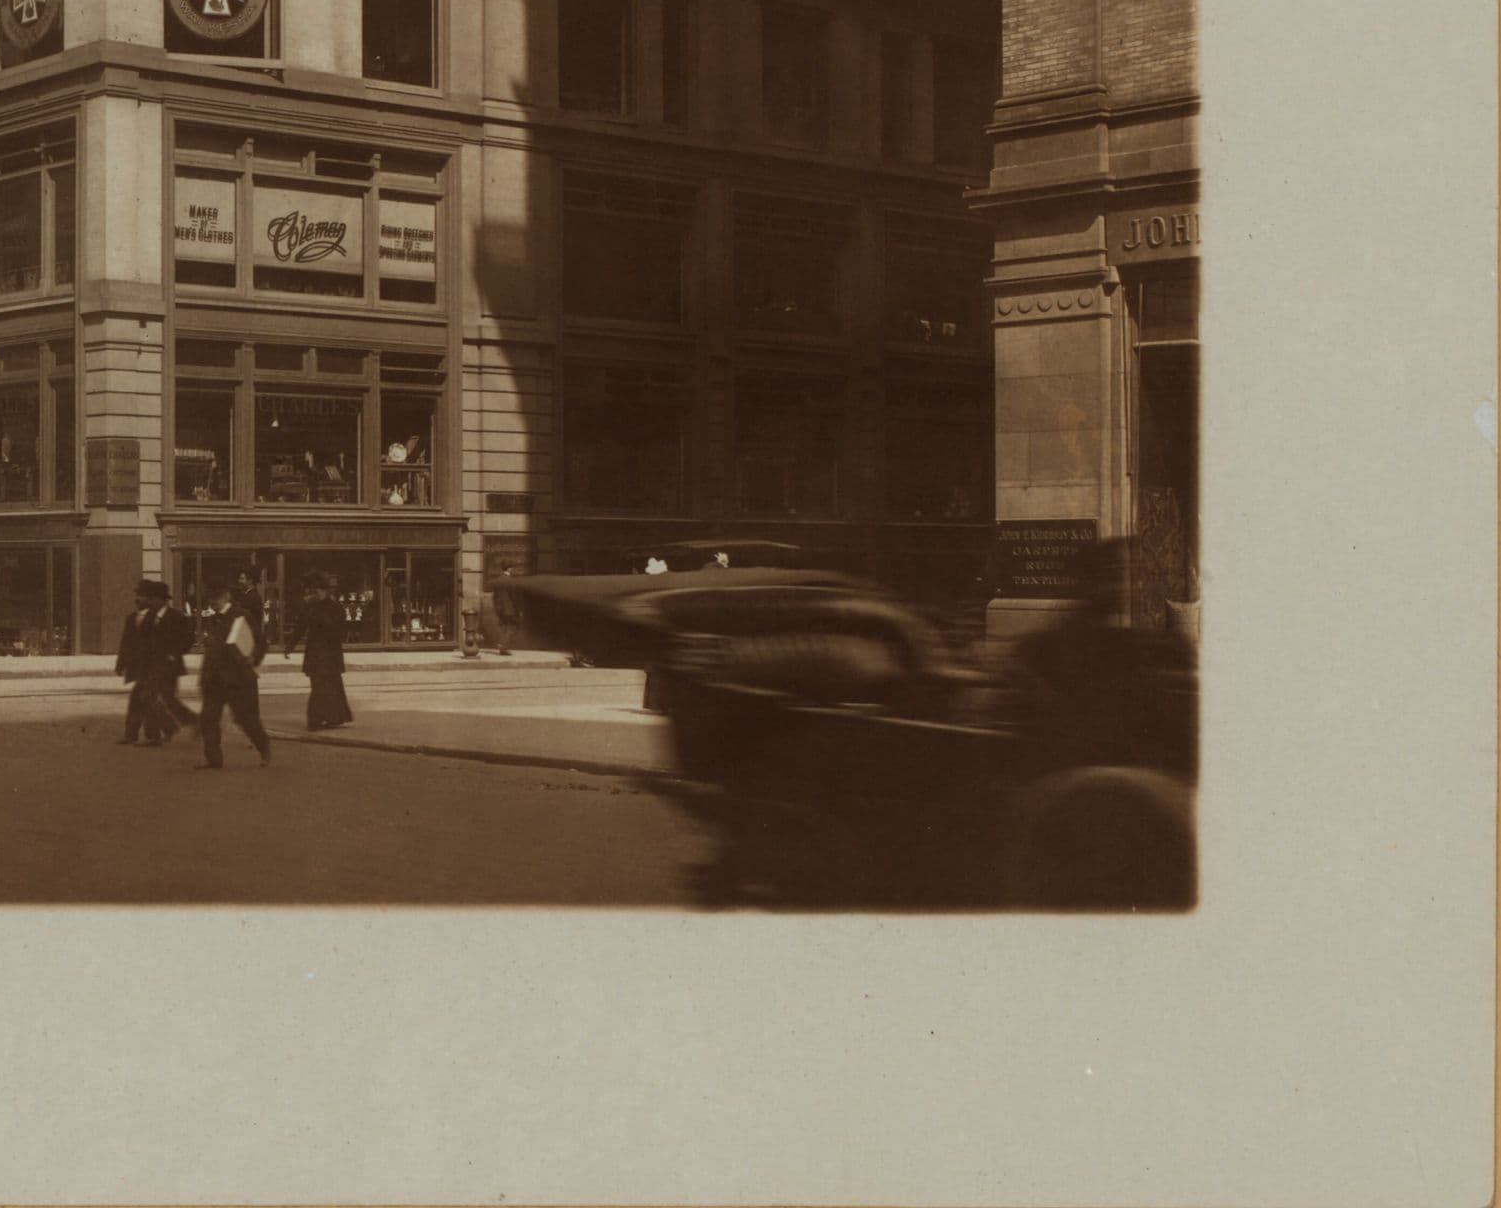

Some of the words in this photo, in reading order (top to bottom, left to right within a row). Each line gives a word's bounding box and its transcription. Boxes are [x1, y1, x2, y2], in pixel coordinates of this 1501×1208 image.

[189, 204, 219, 221] MAKER
[198, 228, 234, 245] CLOTHES
[1012, 546, 1079, 557] CARPETS
